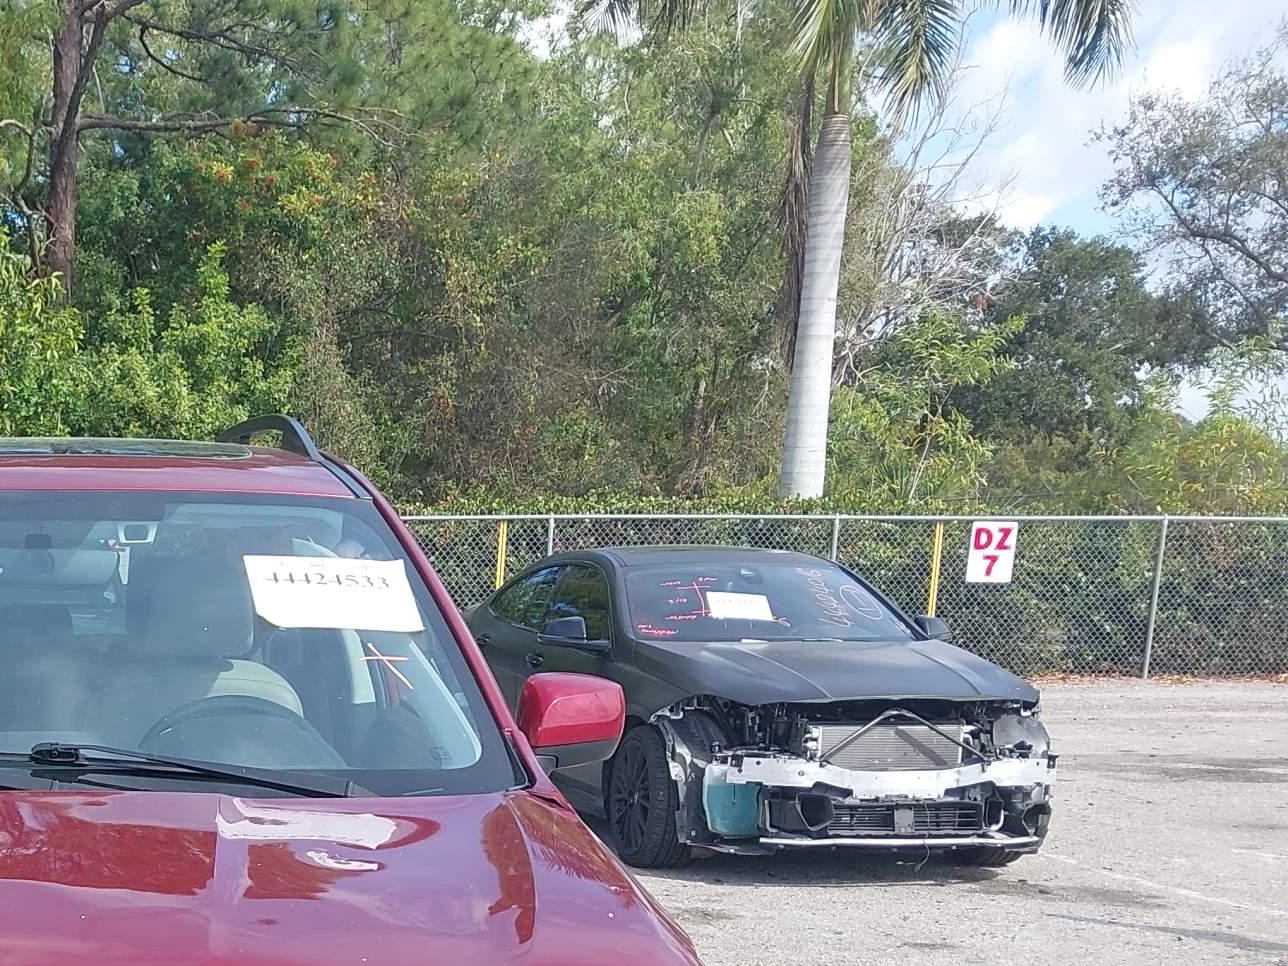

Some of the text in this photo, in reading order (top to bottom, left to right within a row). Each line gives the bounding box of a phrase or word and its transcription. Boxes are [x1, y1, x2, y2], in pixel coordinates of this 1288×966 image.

[974, 527, 1014, 551] DZ
[983, 554, 1000, 577] 7
[265, 571, 391, 589] 44424533
